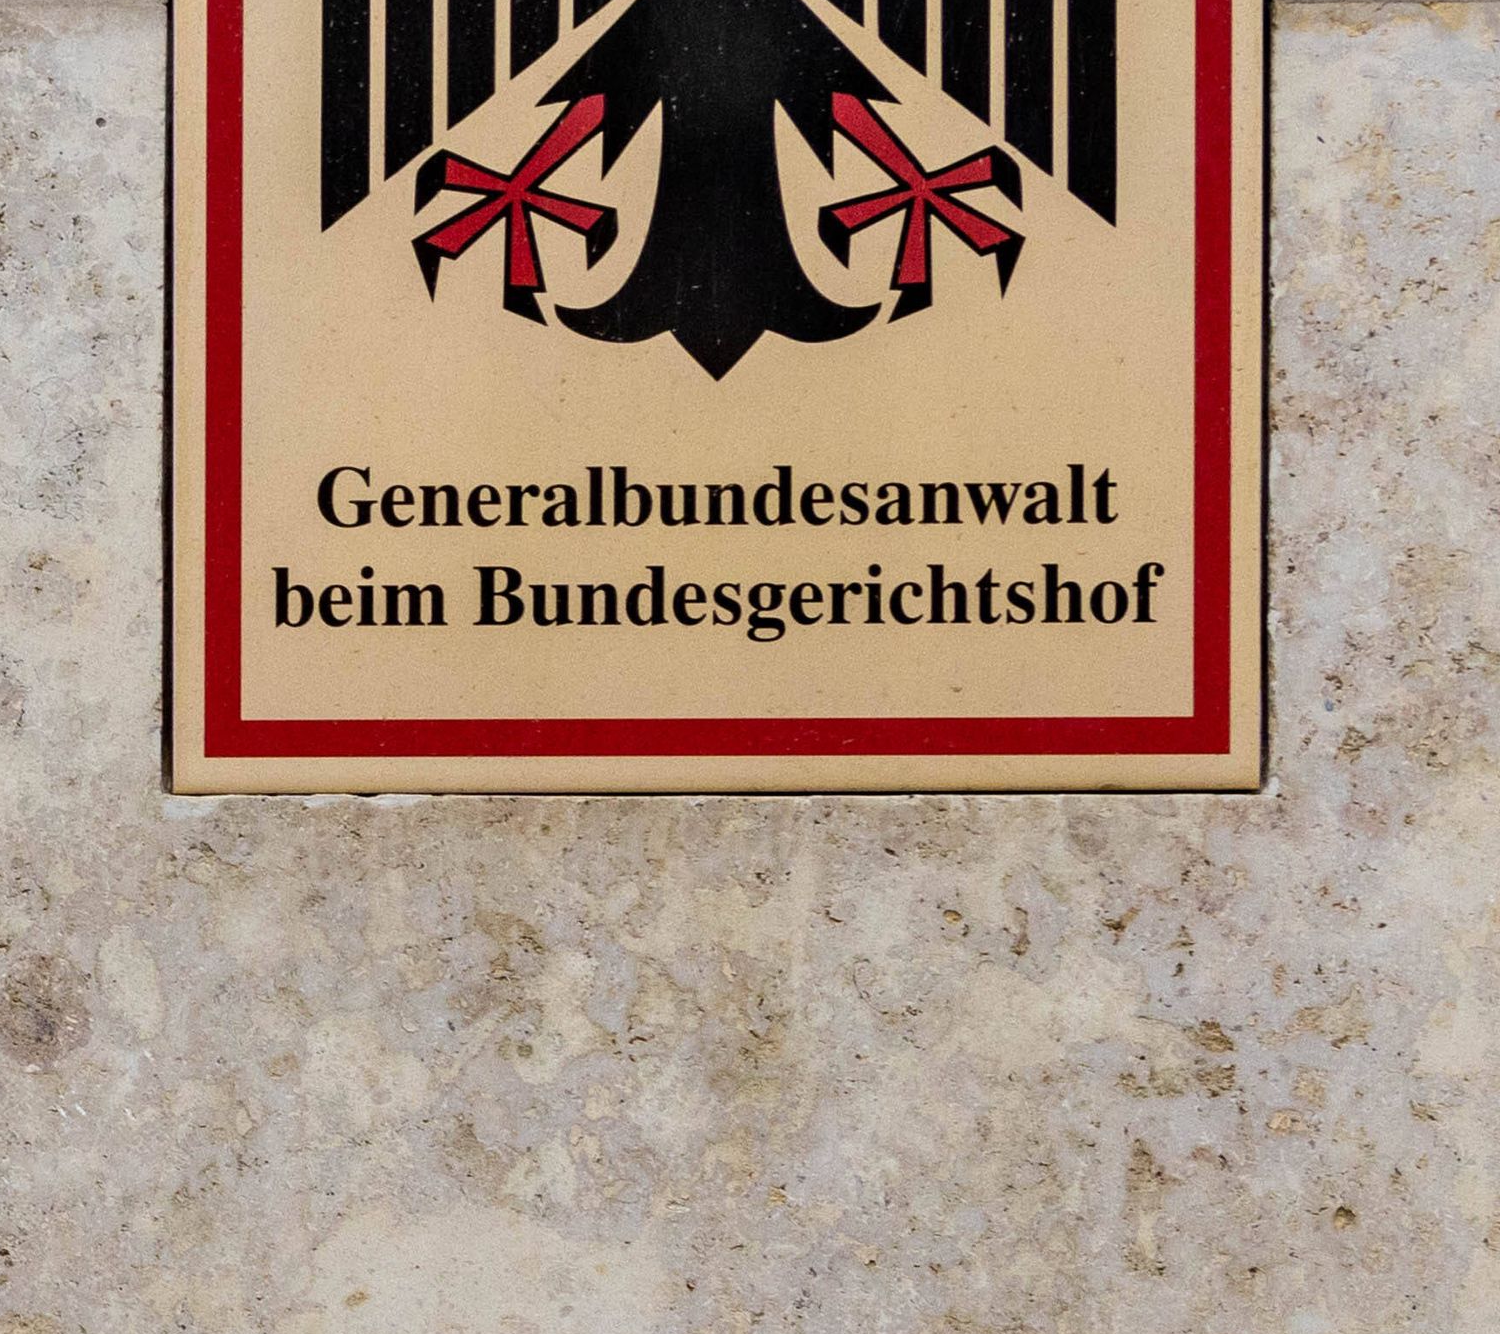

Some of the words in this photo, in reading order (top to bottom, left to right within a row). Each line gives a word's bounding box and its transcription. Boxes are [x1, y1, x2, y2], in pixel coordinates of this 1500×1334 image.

[316, 464, 1120, 530] Generalbundesanwalt
[271, 565, 449, 628] beim
[472, 560, 1166, 643] Bundesgerichtshof
